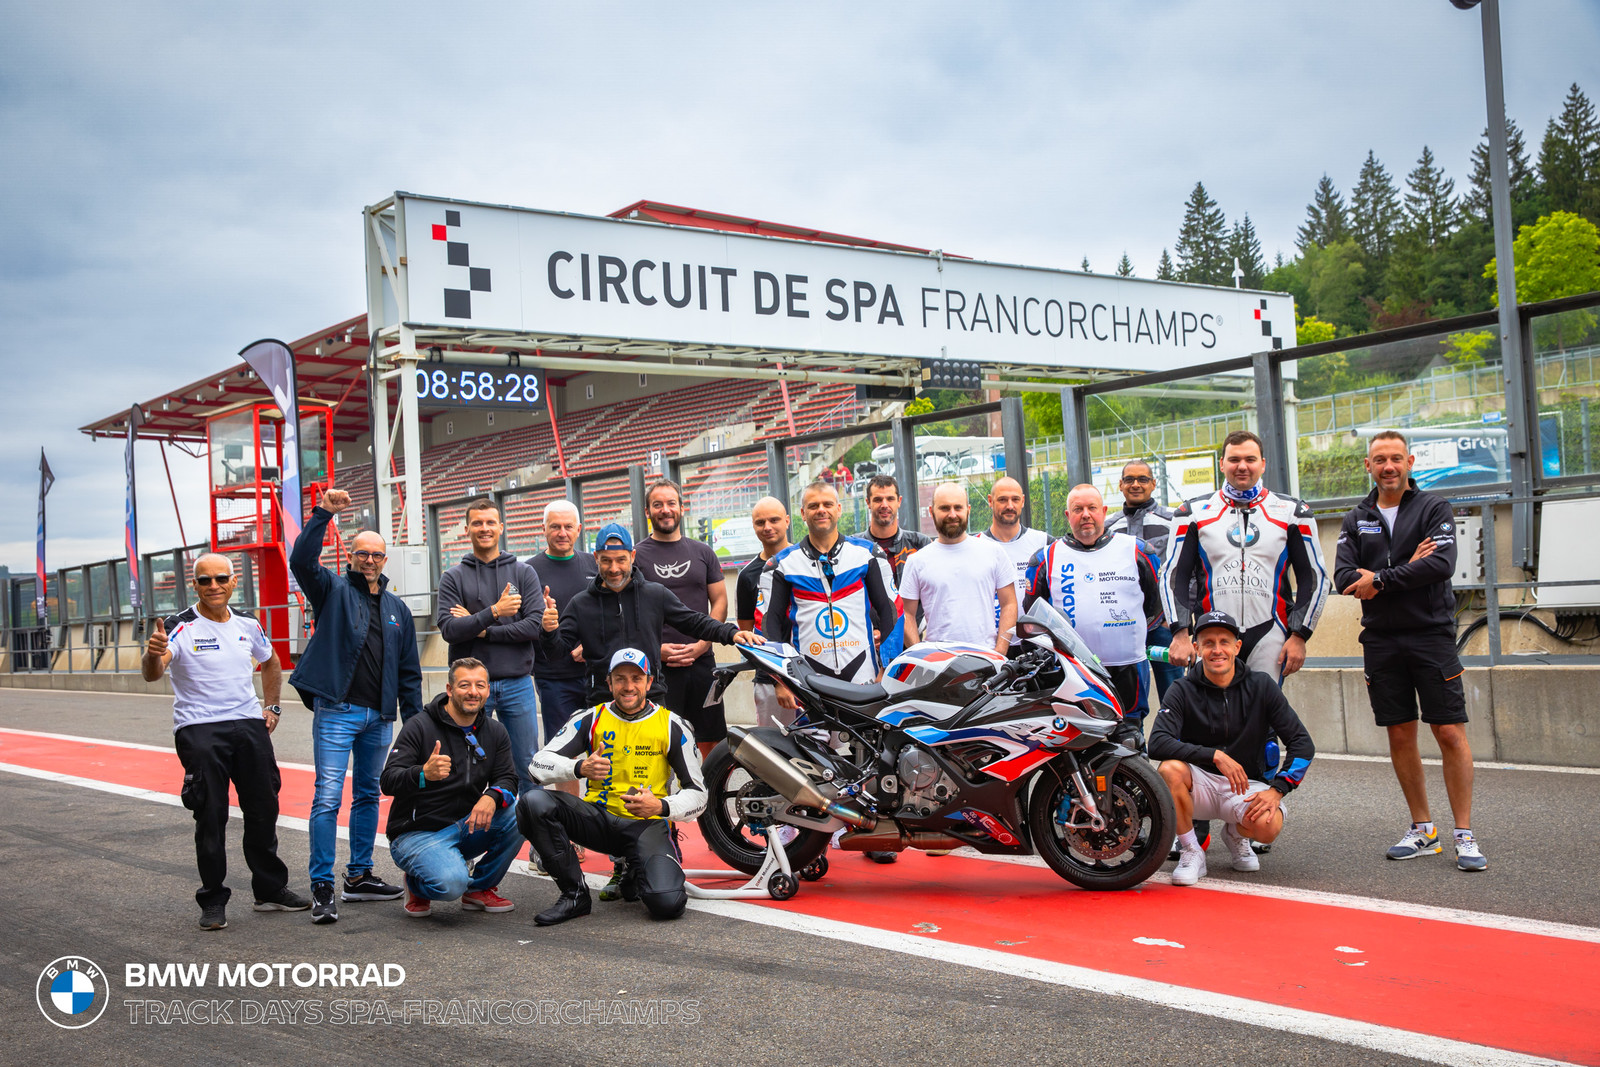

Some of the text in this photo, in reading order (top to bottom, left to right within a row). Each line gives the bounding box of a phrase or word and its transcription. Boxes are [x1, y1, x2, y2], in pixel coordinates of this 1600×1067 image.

[548, 251, 1217, 349] CIRCUIT DE SPA FRANCORCHAMPS
[416, 369, 539, 402] 08:58:28
[588, 386, 592, 398] L
[654, 453, 658, 464] P
[1216, 575, 1268, 588] EVASION
[822, 640, 860, 648] Location
[534, 761, 555, 770] Motorrad
